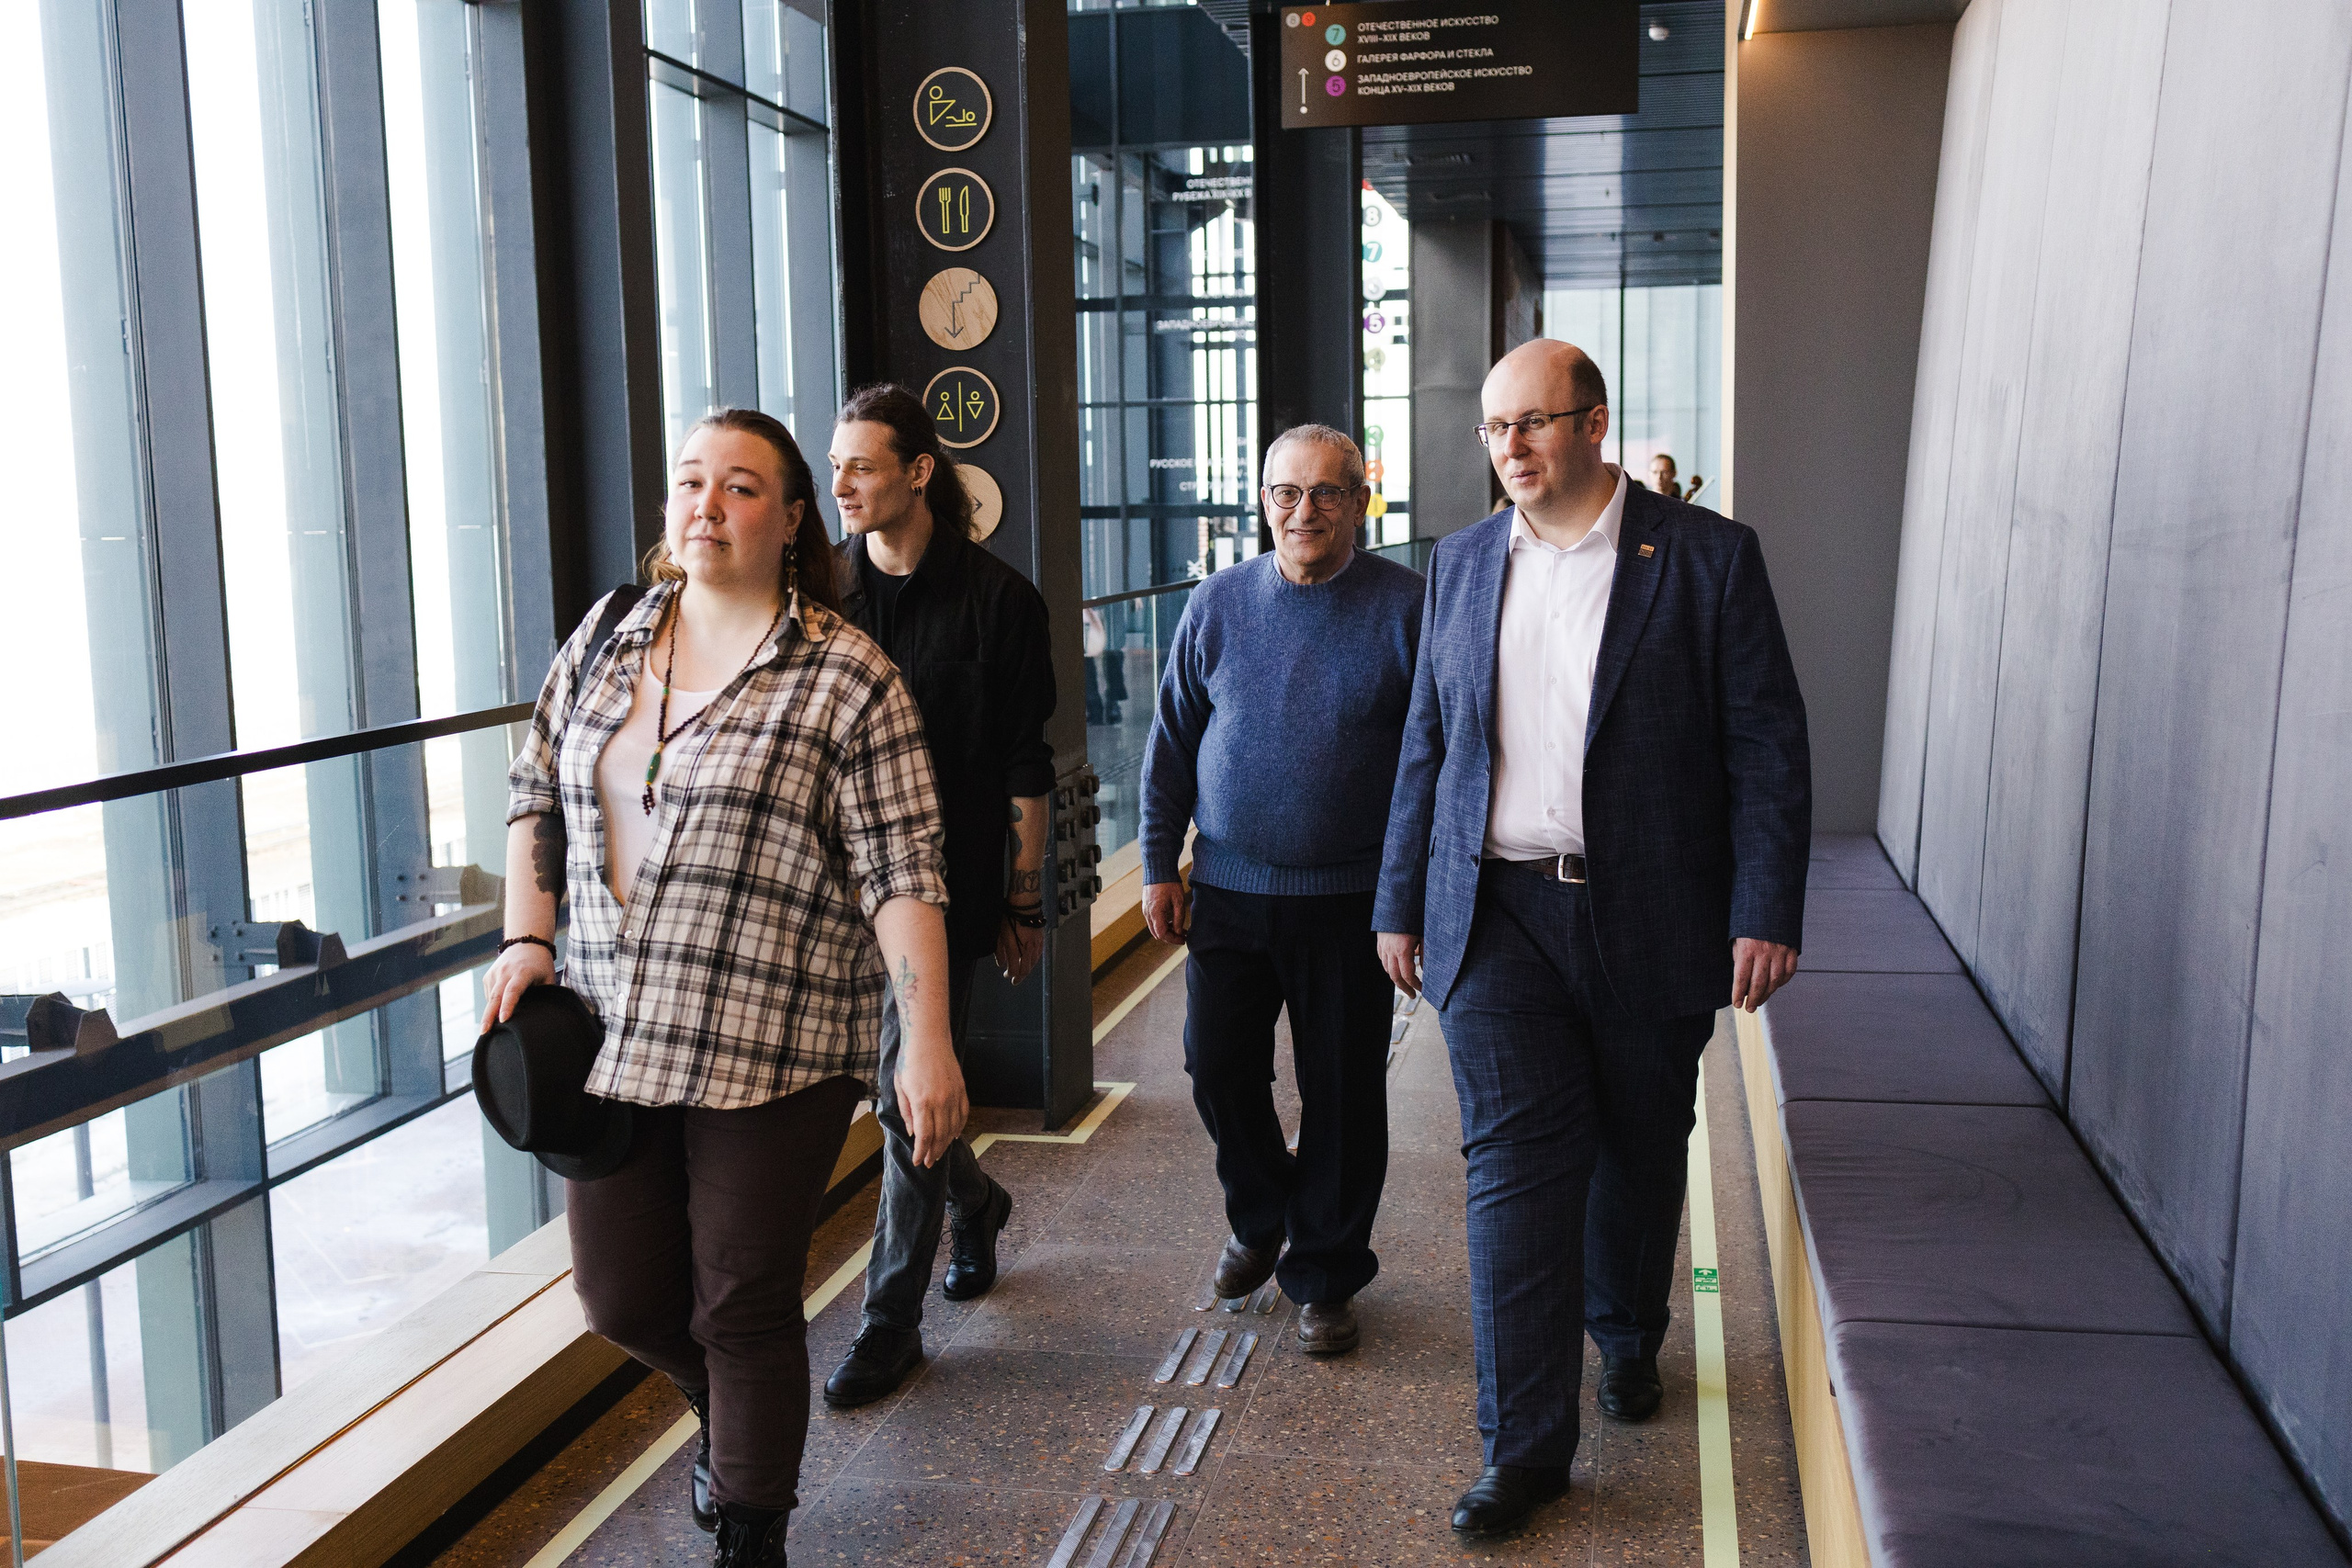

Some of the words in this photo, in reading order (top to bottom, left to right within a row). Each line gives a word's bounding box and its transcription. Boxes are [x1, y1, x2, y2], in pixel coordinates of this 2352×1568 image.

[1357, 18, 1439, 31] ОТЕЧЕСТВЕННОЕ
[1440, 16, 1498, 27] ИСКУССТВО
[1332, 28, 1340, 41] 7
[1398, 31, 1430, 41] ВЕКОВ
[1331, 54, 1340, 66] 6
[1357, 52, 1398, 63] ГАЛЕРЕЯ
[1399, 51, 1446, 62] ФАРФОРА
[1447, 50, 1455, 59] И
[1455, 48, 1494, 58] СТЕКЛА
[1357, 68, 1473, 84] ЗАПАДНОЕВРОПЕЙСКОЕ
[1474, 65, 1533, 77] ИСКУССТВО
[1331, 79, 1340, 92] 5
[1357, 85, 1390, 96] КОНЦА
[1423, 82, 1455, 92] ВЕКОВ
[1365, 208, 1380, 226] 8
[1366, 243, 1380, 262] 7
[1368, 314, 1384, 333] 5
